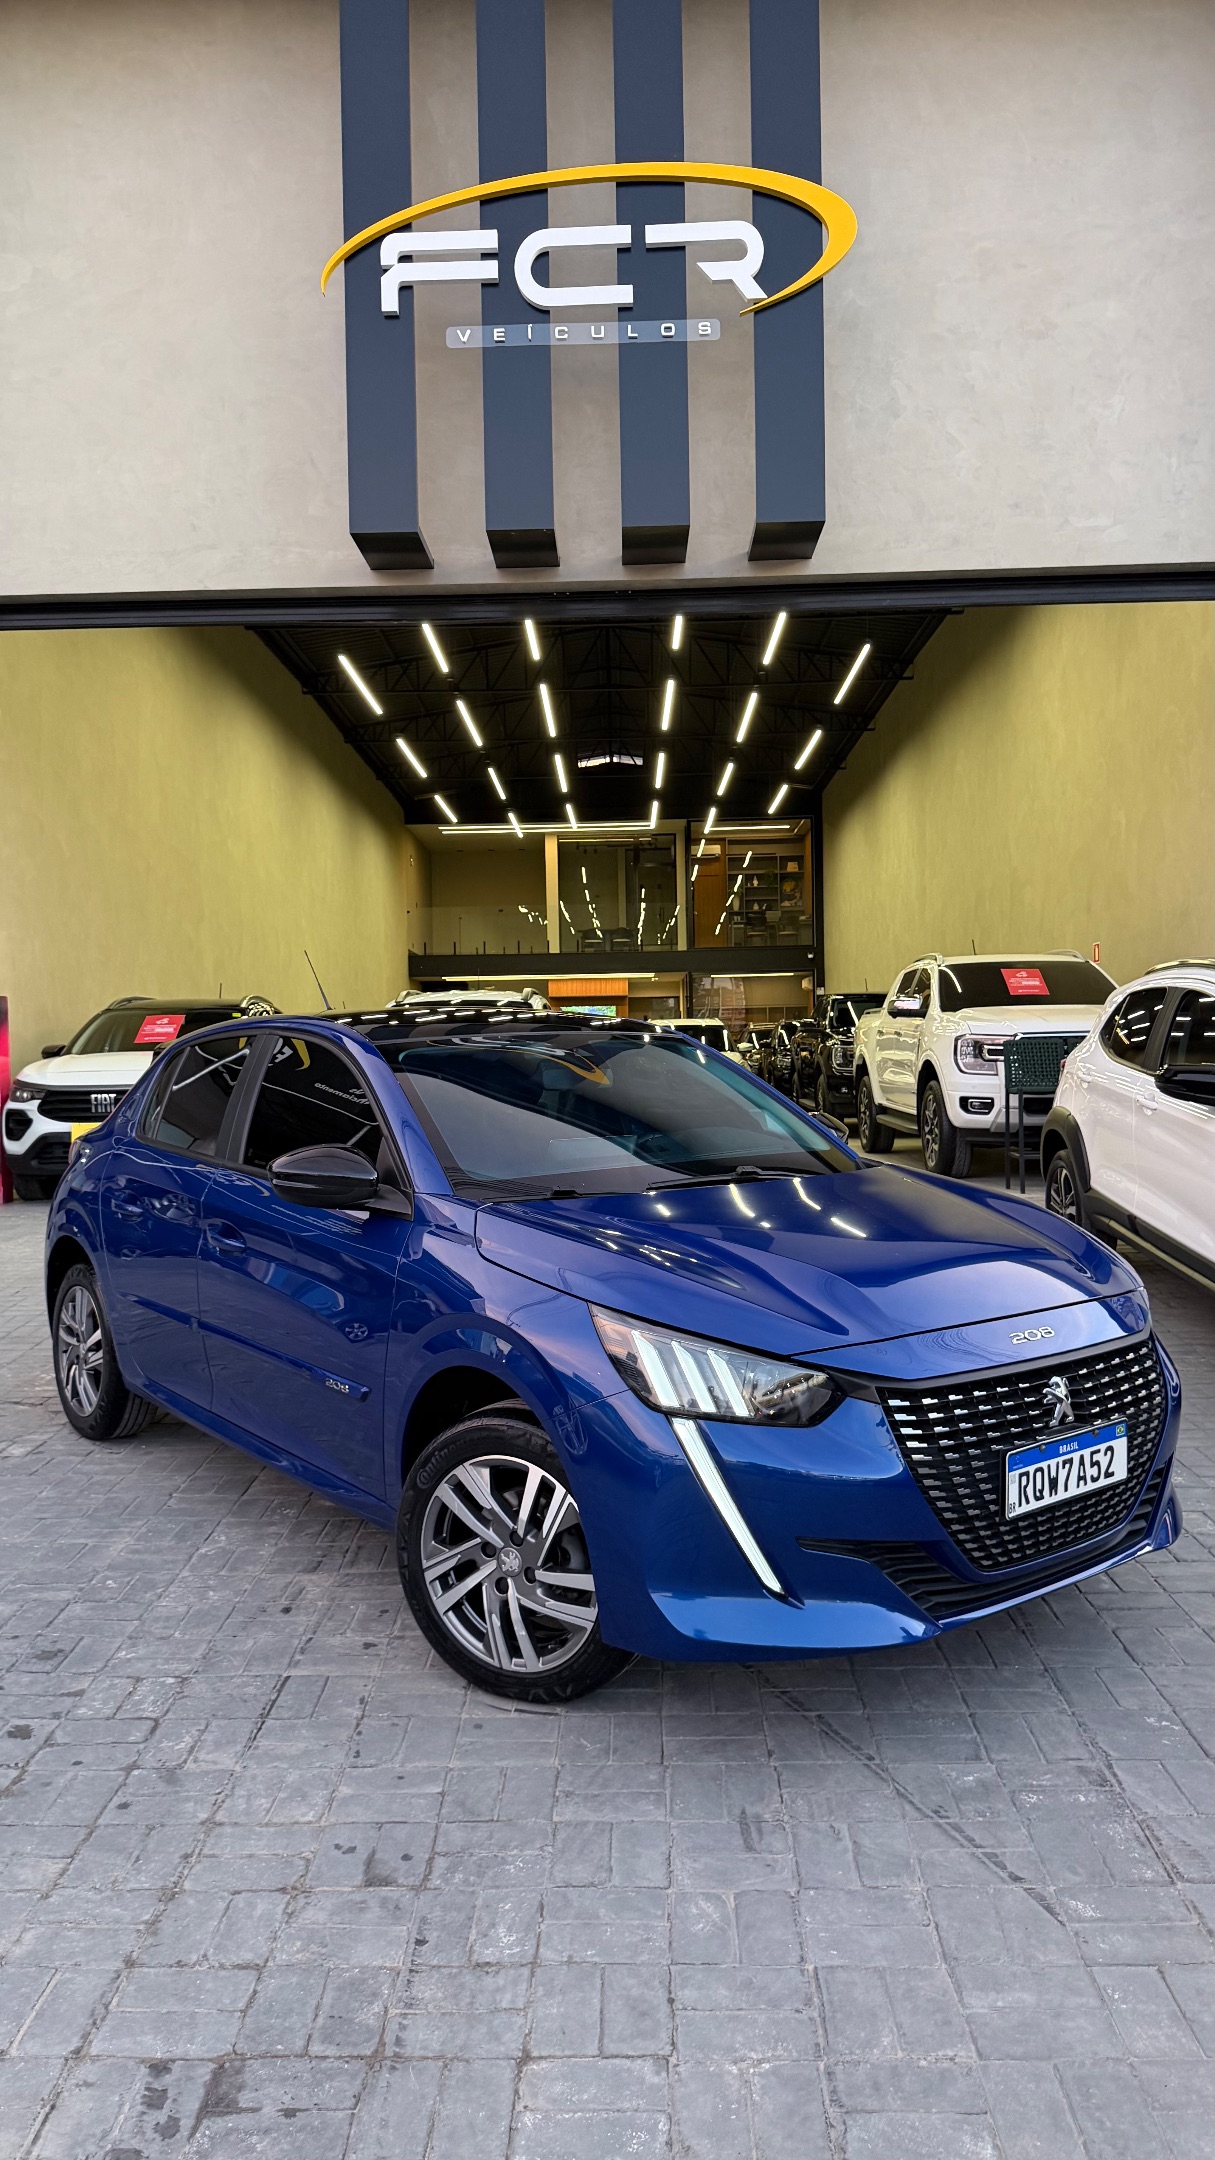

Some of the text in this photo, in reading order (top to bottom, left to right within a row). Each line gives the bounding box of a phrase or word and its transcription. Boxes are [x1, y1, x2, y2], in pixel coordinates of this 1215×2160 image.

[380, 219, 768, 316] FCR
[457, 321, 712, 344] VEÍCULOS
[90, 1093, 117, 1113] FIAT
[1009, 1326, 1055, 1345] 208
[325, 1378, 349, 1393] 208
[1059, 1441, 1079, 1454] BRASIL
[1018, 1444, 1115, 1508] RQW7A52
[1009, 1502, 1016, 1514] BR
